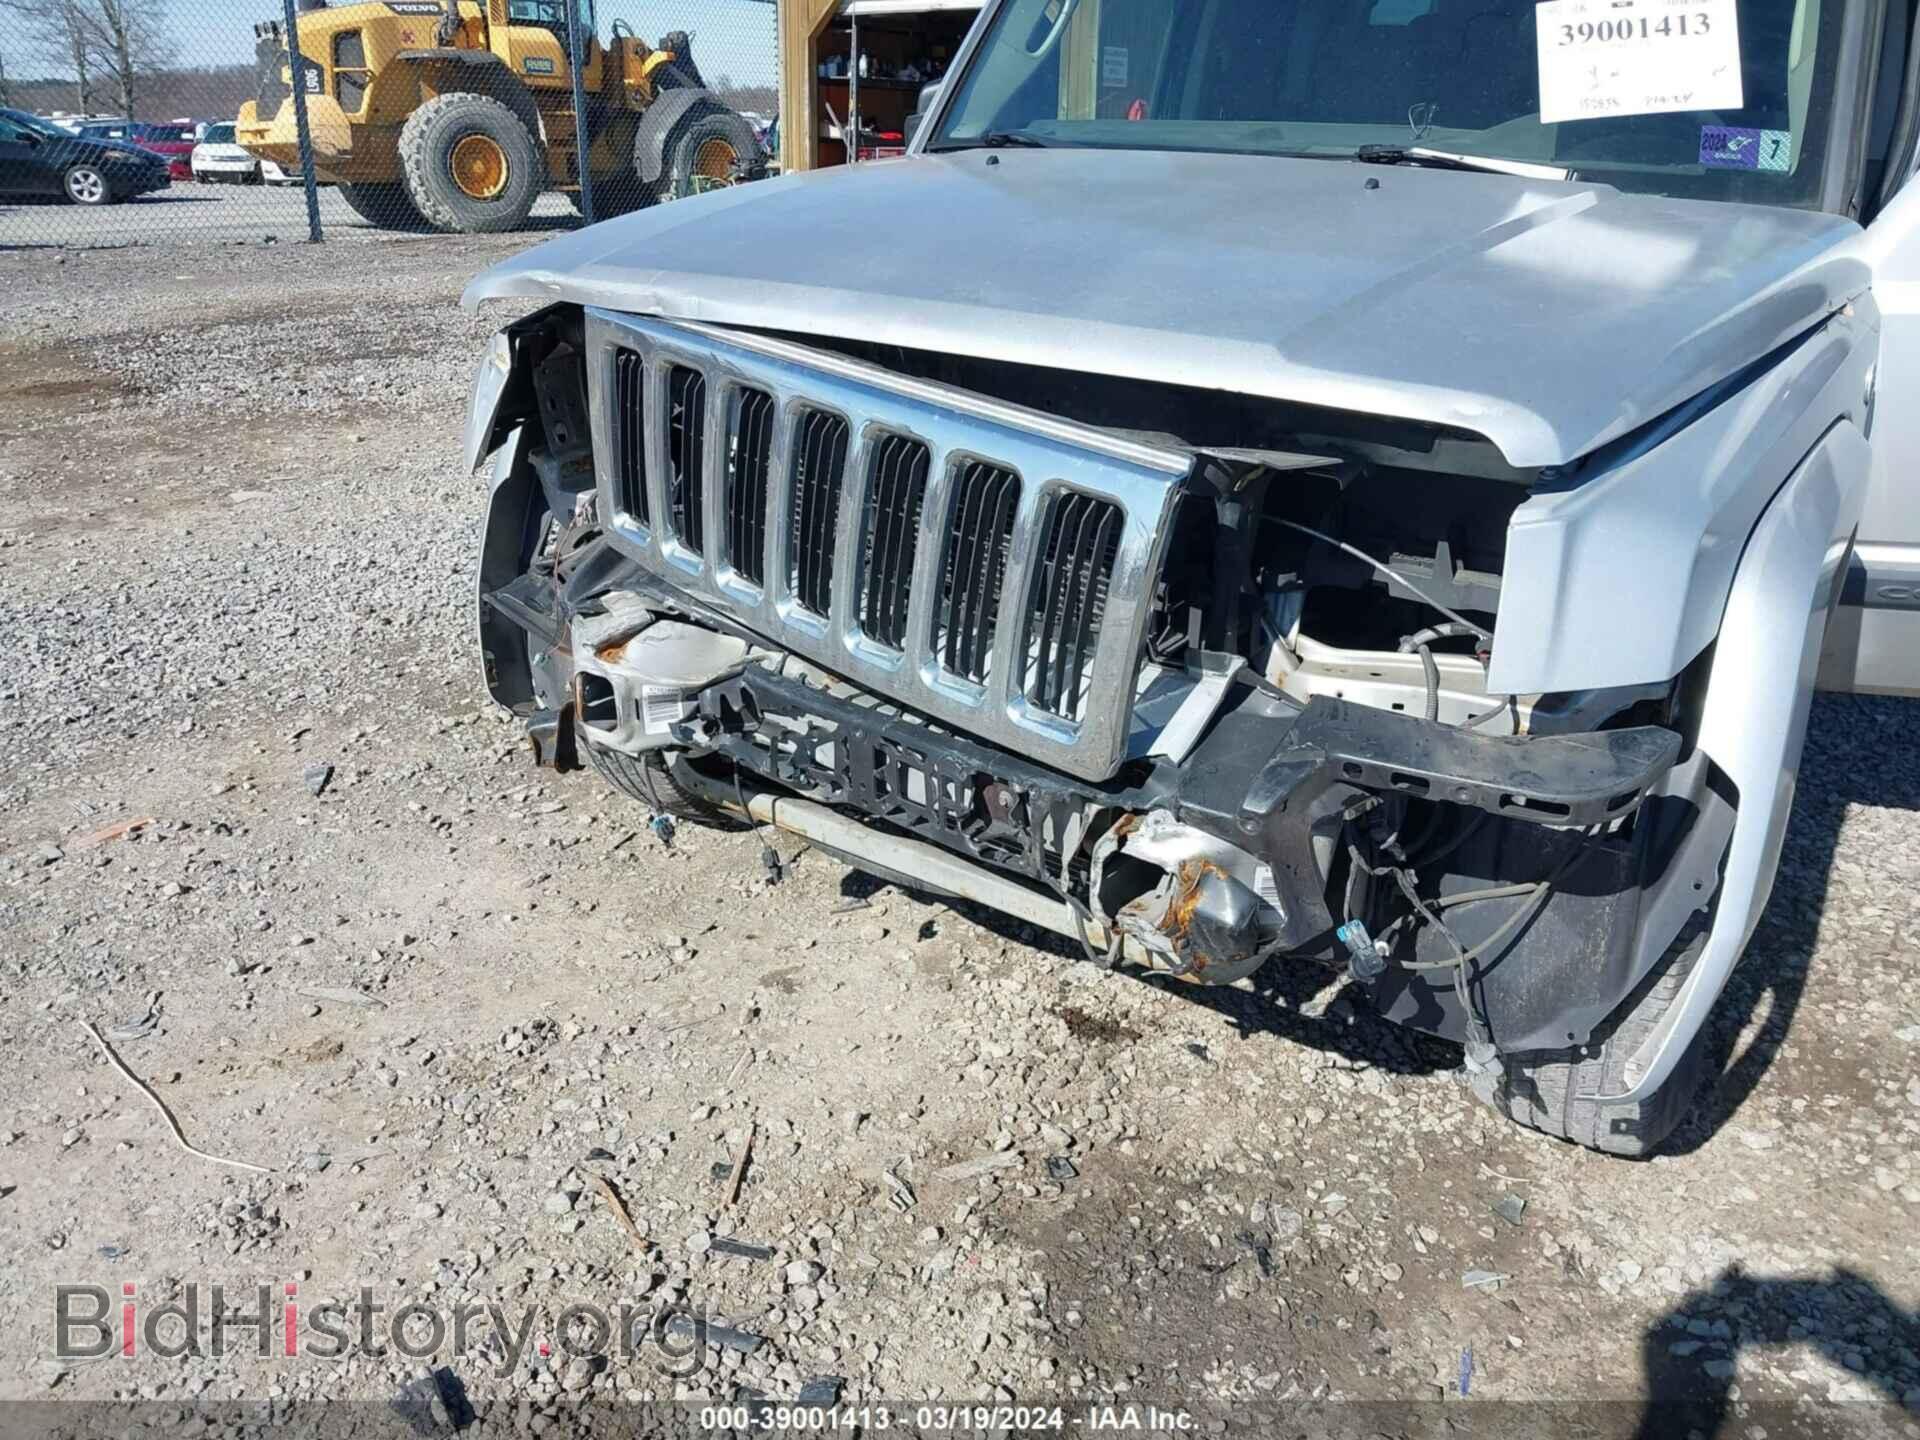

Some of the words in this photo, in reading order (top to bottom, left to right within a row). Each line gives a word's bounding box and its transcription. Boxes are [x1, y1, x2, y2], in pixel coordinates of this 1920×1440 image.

[392, 4, 438, 12] VOLVO
[1558, 12, 1711, 46] 39001413
[1771, 139, 1780, 160] 7
